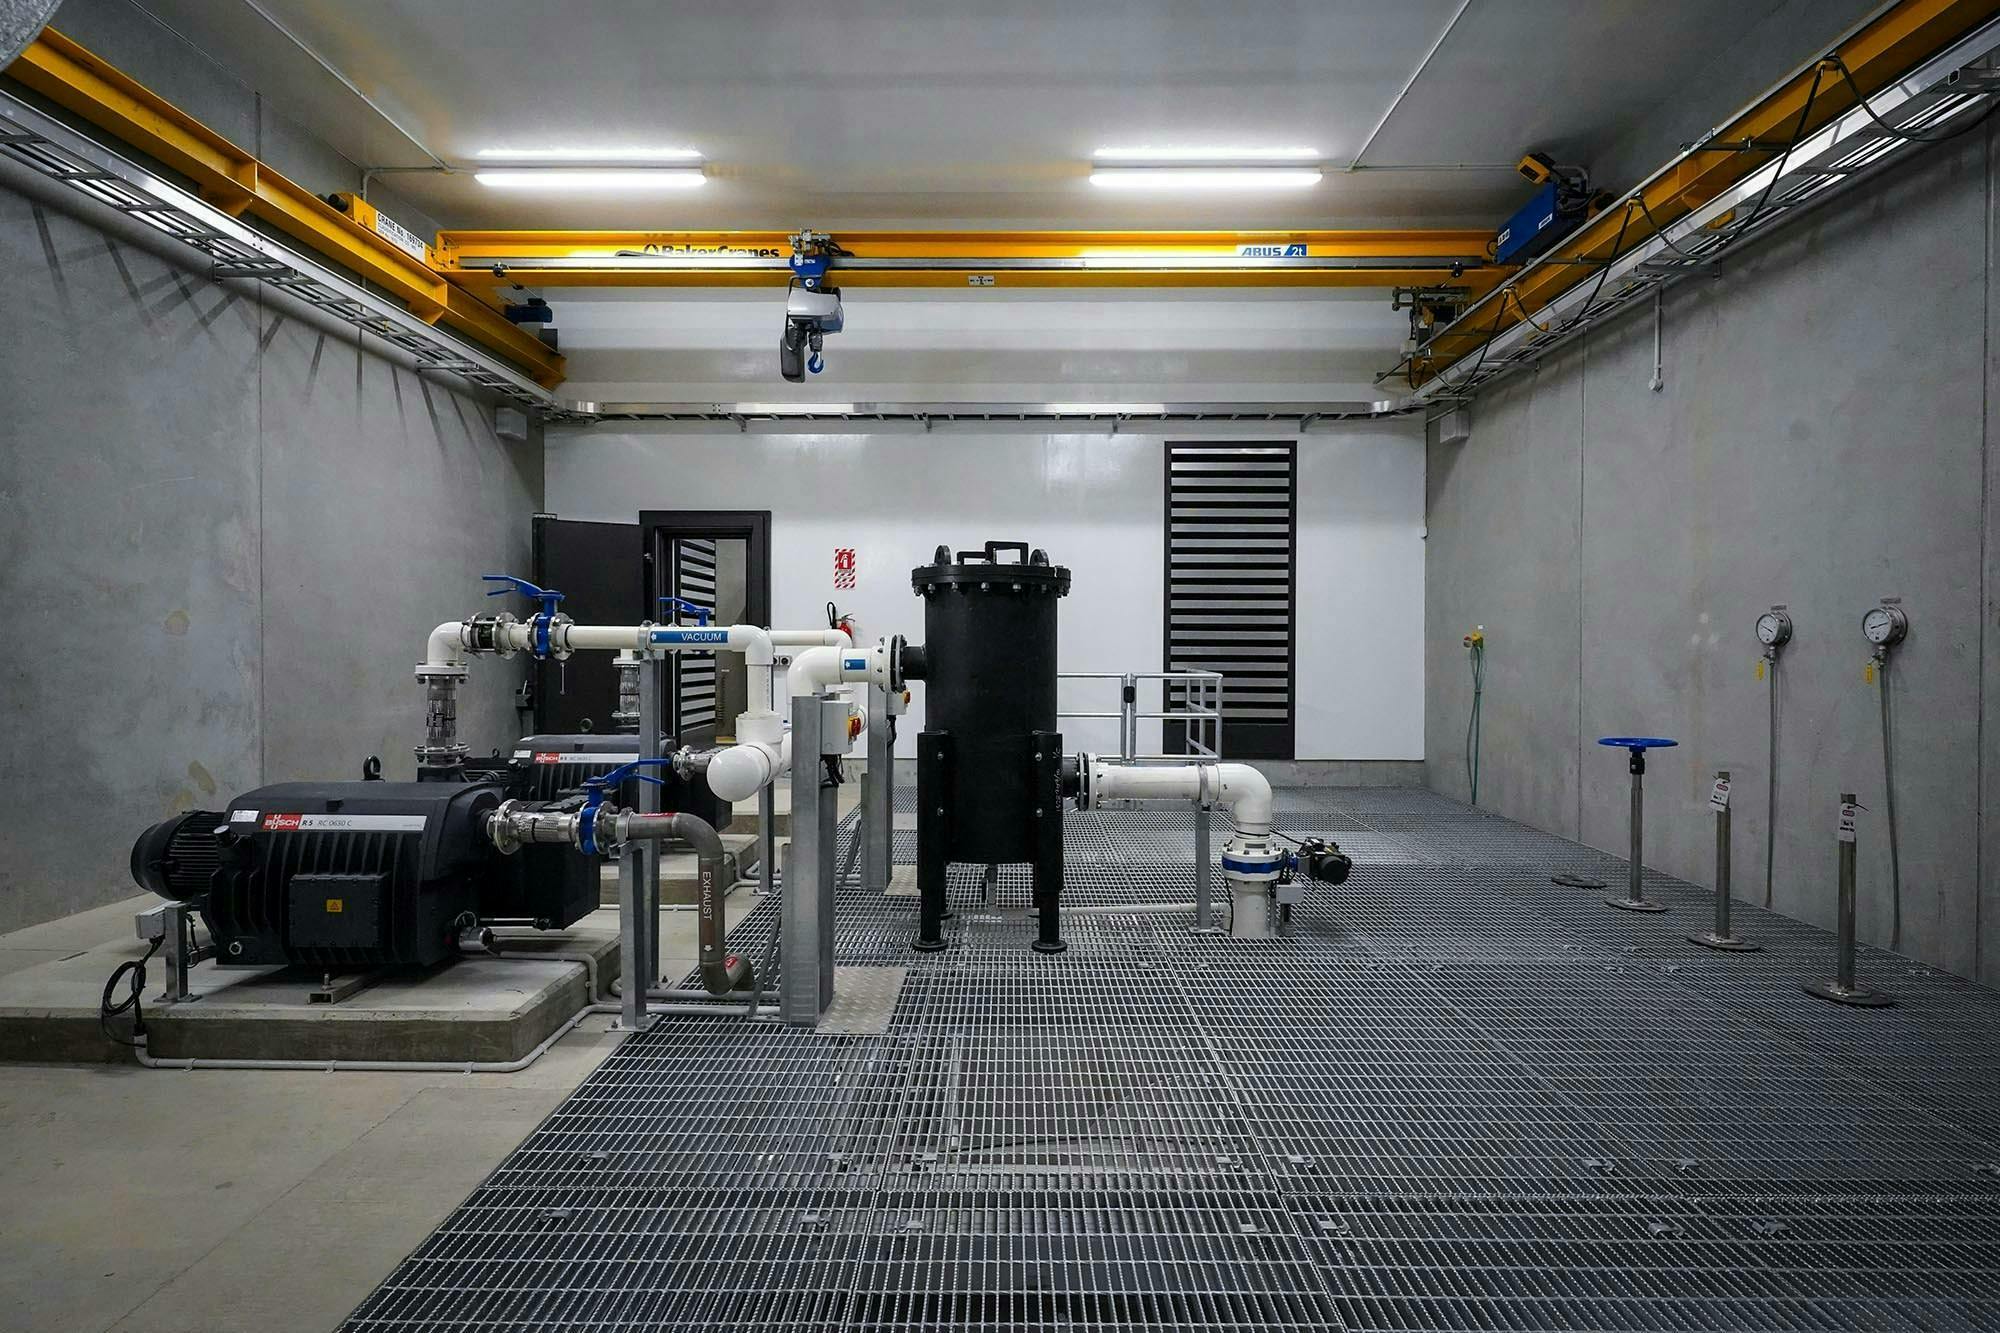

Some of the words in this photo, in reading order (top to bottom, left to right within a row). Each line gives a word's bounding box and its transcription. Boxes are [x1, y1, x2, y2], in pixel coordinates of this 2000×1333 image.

[378, 213, 395, 231] CRANE
[1242, 247, 1282, 256] ABUS
[1292, 247, 1303, 256] 2t
[681, 632, 722, 641] VACUUM
[703, 871, 712, 920] EXHAUST
